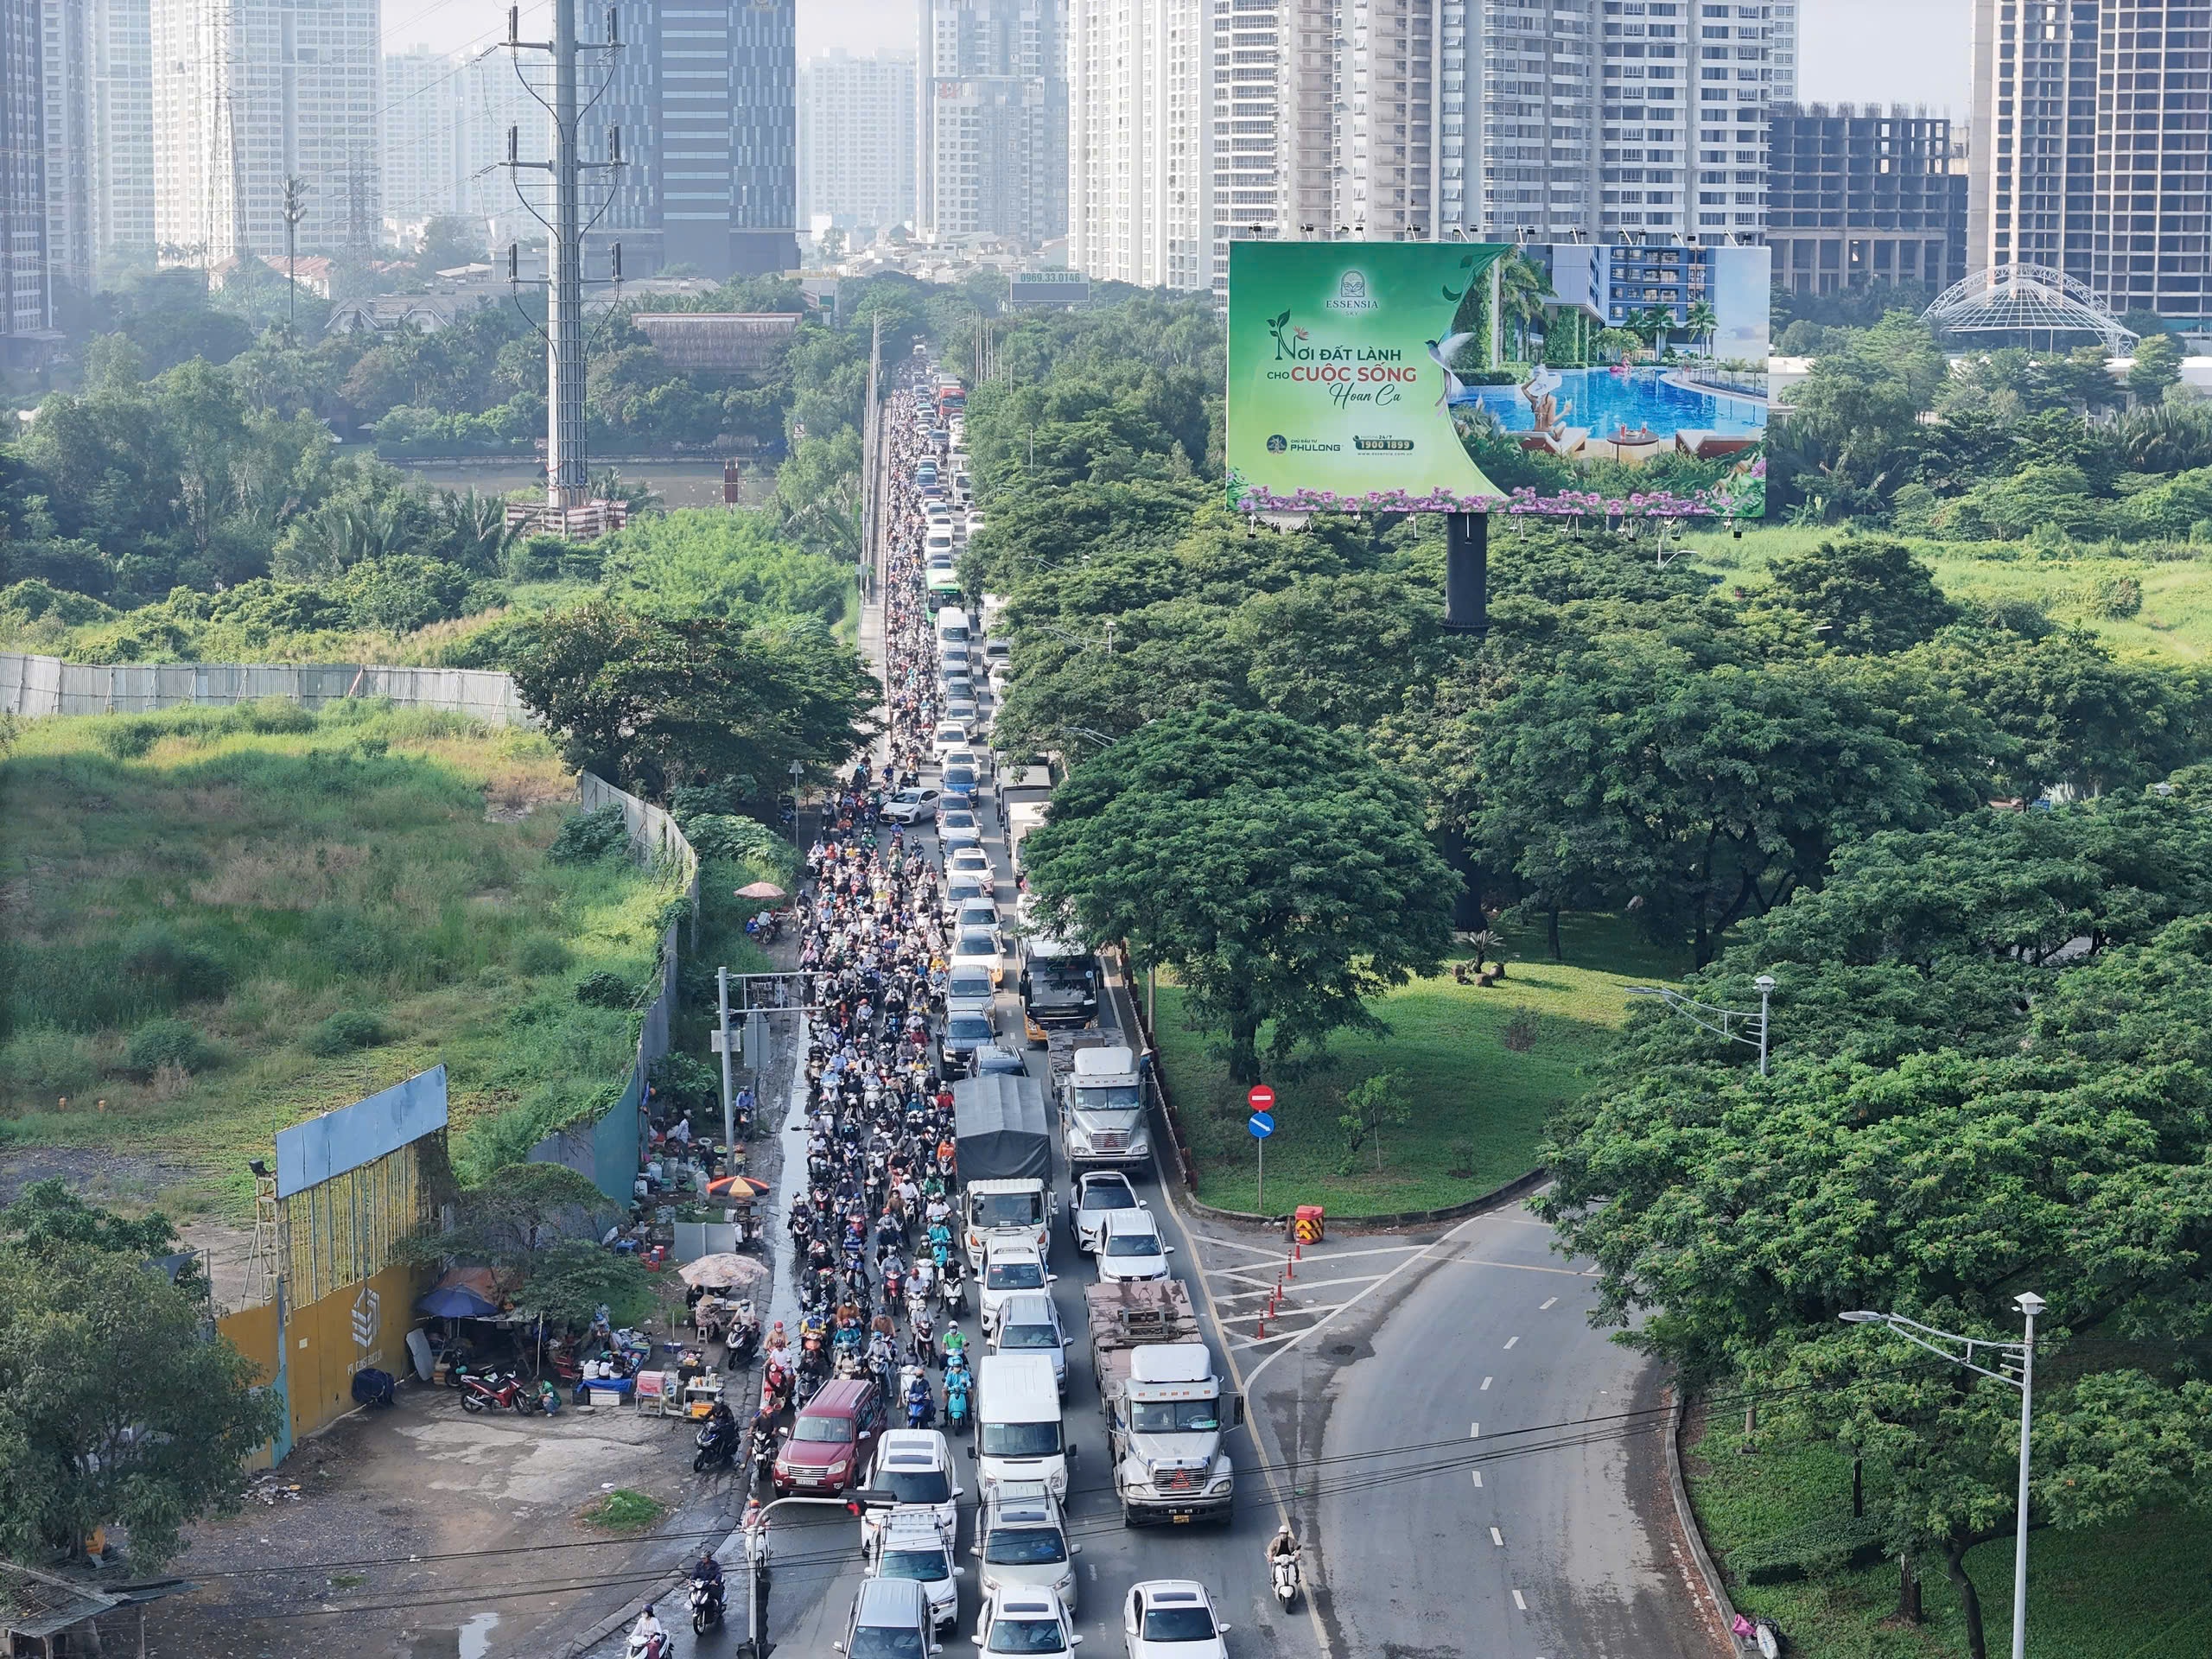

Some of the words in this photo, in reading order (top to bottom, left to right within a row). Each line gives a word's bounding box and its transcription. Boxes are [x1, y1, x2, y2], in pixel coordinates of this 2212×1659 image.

[1020, 272, 1080, 283] 0969.33.0146
[1326, 300, 1378, 308] ESSENSIA
[1319, 346, 1353, 361] ĐẤT
[1357, 346, 1402, 361] LÀNH
[1291, 363, 1351, 385] CUỘC
[1357, 361, 1417, 383] SỐNG
[1329, 382, 1372, 410] Hoan
[1375, 384, 1402, 406] Ca
[1290, 443, 1341, 452] PHULONG
[1361, 441, 1384, 449] 1900
[1386, 441, 1410, 449] 1899
